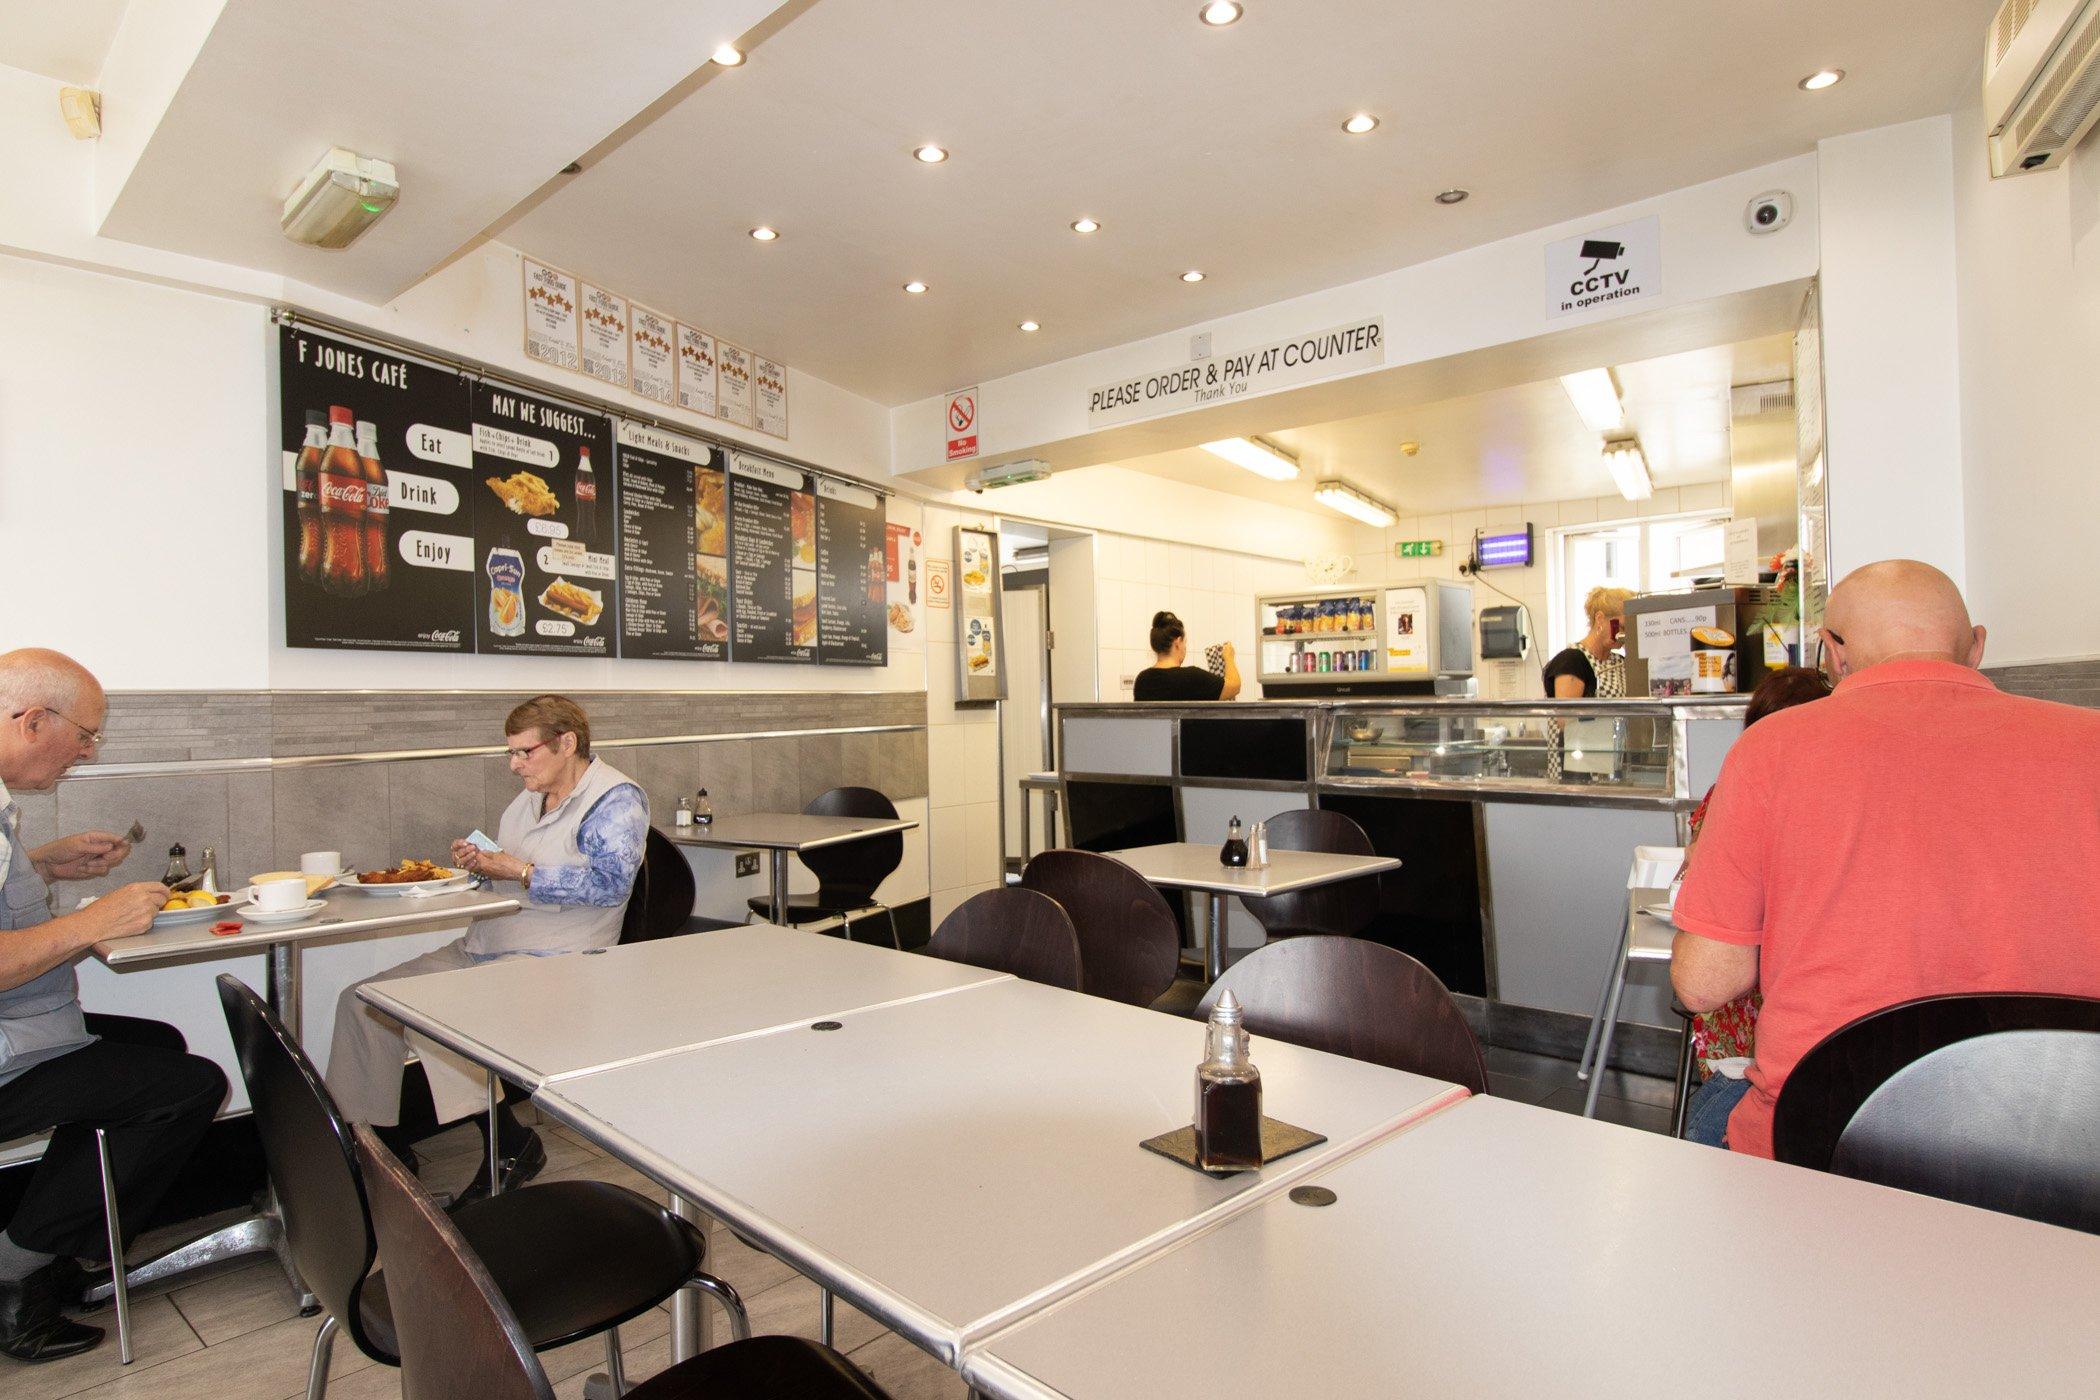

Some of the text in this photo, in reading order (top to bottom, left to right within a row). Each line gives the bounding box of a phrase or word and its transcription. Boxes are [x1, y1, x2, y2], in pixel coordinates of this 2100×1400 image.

[1570, 269, 1629, 296] CCTV
[1561, 286, 1640, 311] in operation
[299, 339, 408, 389] F JONES CAFÉ
[539, 344, 577, 370] 2012
[1092, 324, 1379, 412] PLEASE ORDER & PAY AT COUNTER
[1194, 381, 1248, 403] Thank You
[492, 394, 516, 418] MAY
[520, 401, 536, 424] WE
[421, 434, 442, 454] Eat
[516, 436, 531, 447] Drink
[629, 430, 645, 445] Light
[647, 435, 663, 449] Meals
[957, 440, 967, 448] No
[949, 446, 976, 457] Smoking
[401, 482, 437, 505] Drink
[416, 540, 451, 564] Enjoy
[544, 554, 549, 565] 2
[543, 622, 567, 634] £2.75
[1663, 628, 1687, 637] BOTTLES
